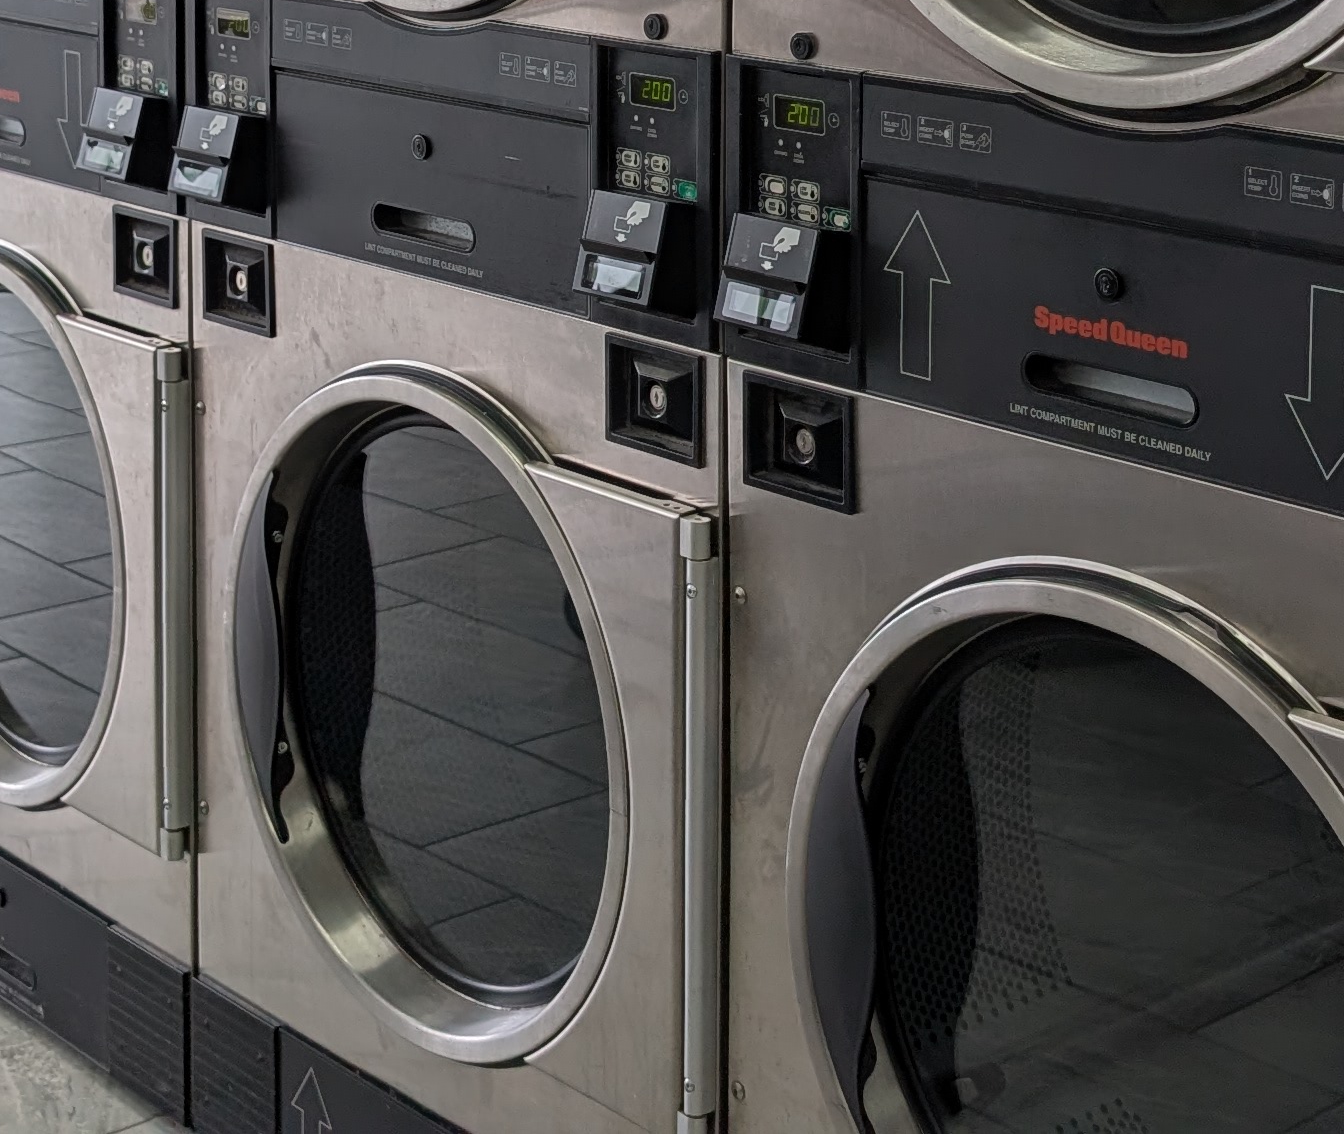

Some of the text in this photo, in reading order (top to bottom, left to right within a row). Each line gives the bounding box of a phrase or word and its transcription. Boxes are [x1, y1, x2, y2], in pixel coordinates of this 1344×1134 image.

[641, 79, 671, 102] 200
[787, 103, 820, 126] 200
[376, 244, 416, 262] COMPARTMENT
[416, 255, 432, 266] MUST
[432, 258, 441, 268] BE
[441, 260, 467, 275] CLEANED
[467, 267, 484, 278] DAILY
[1034, 305, 1188, 359] Speed Queen
[1009, 402, 1212, 462] LINT COMPARTMENT MUST BE CLEANED DAILY
